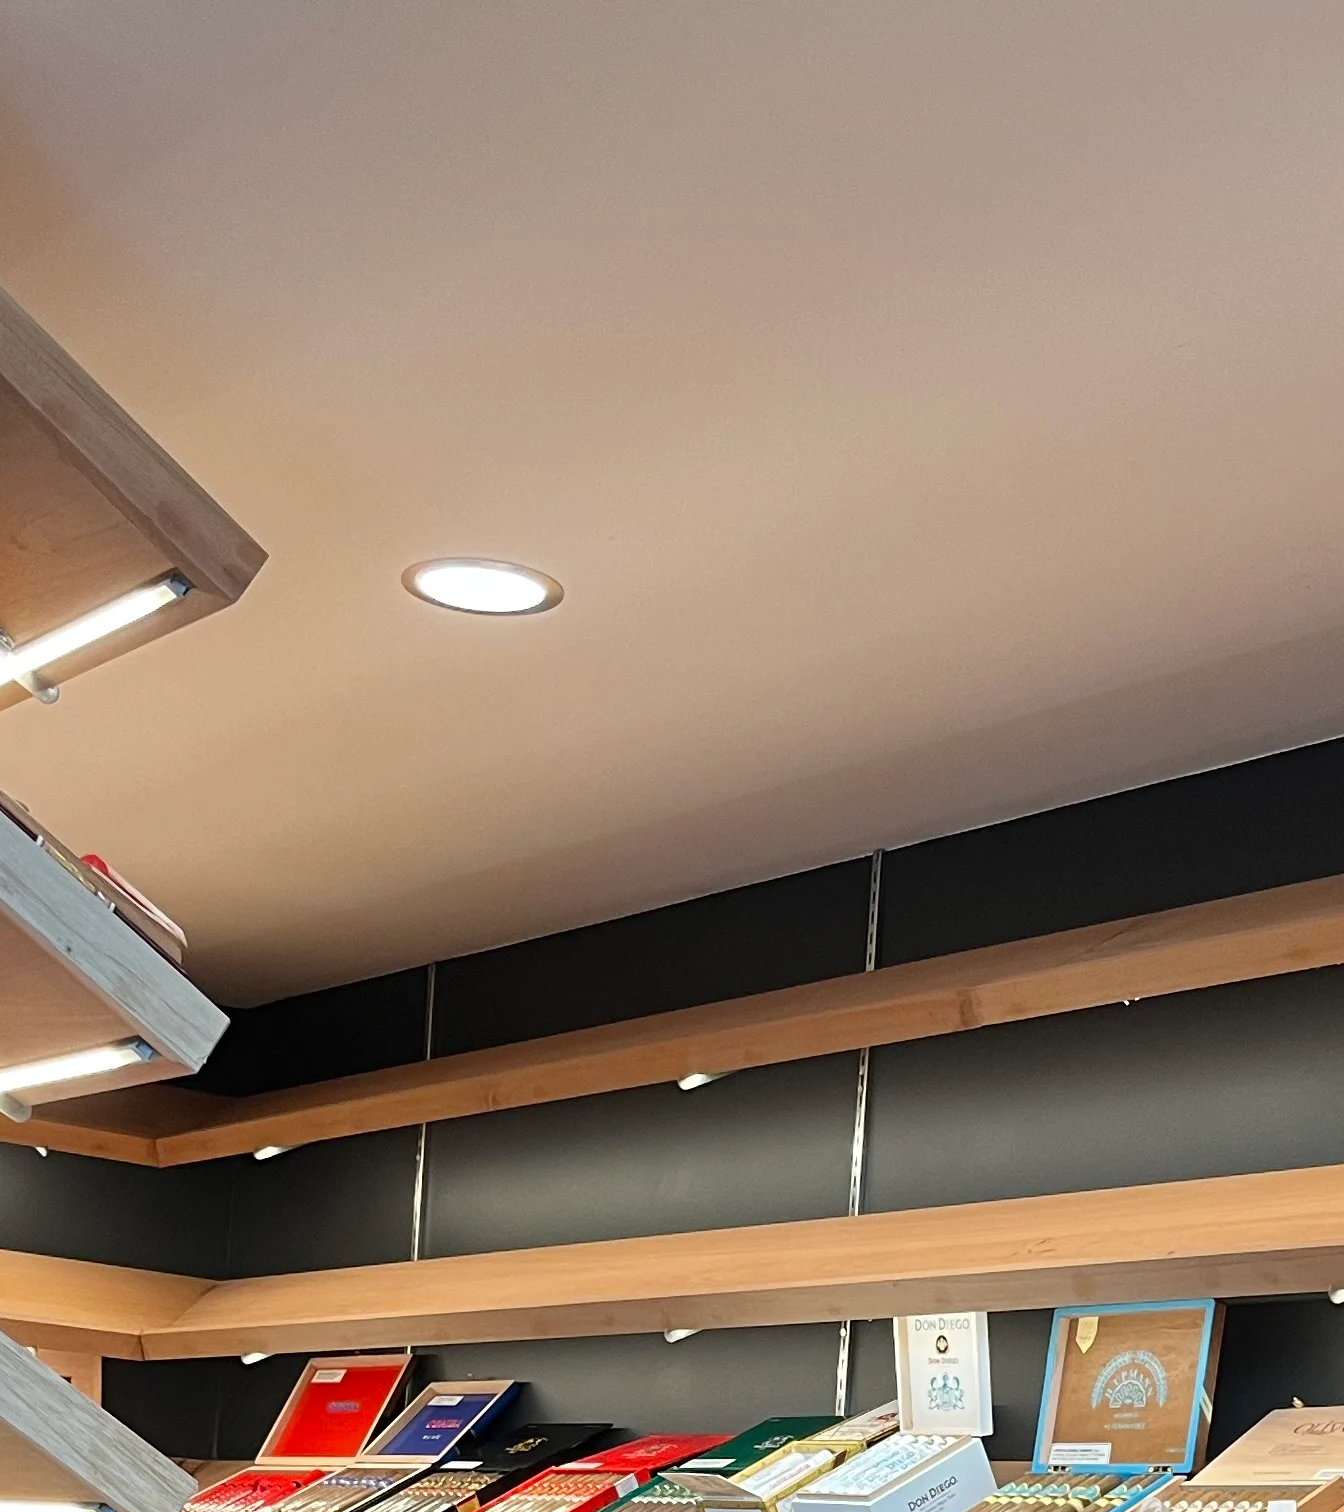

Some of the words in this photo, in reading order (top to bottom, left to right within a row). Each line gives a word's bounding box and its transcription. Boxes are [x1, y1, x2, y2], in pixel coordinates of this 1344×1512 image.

[915, 1319, 936, 1331] DON
[938, 1318, 970, 1330] DIEGO
[907, 1494, 930, 1512] DON
[928, 1476, 957, 1499] DIEGO
